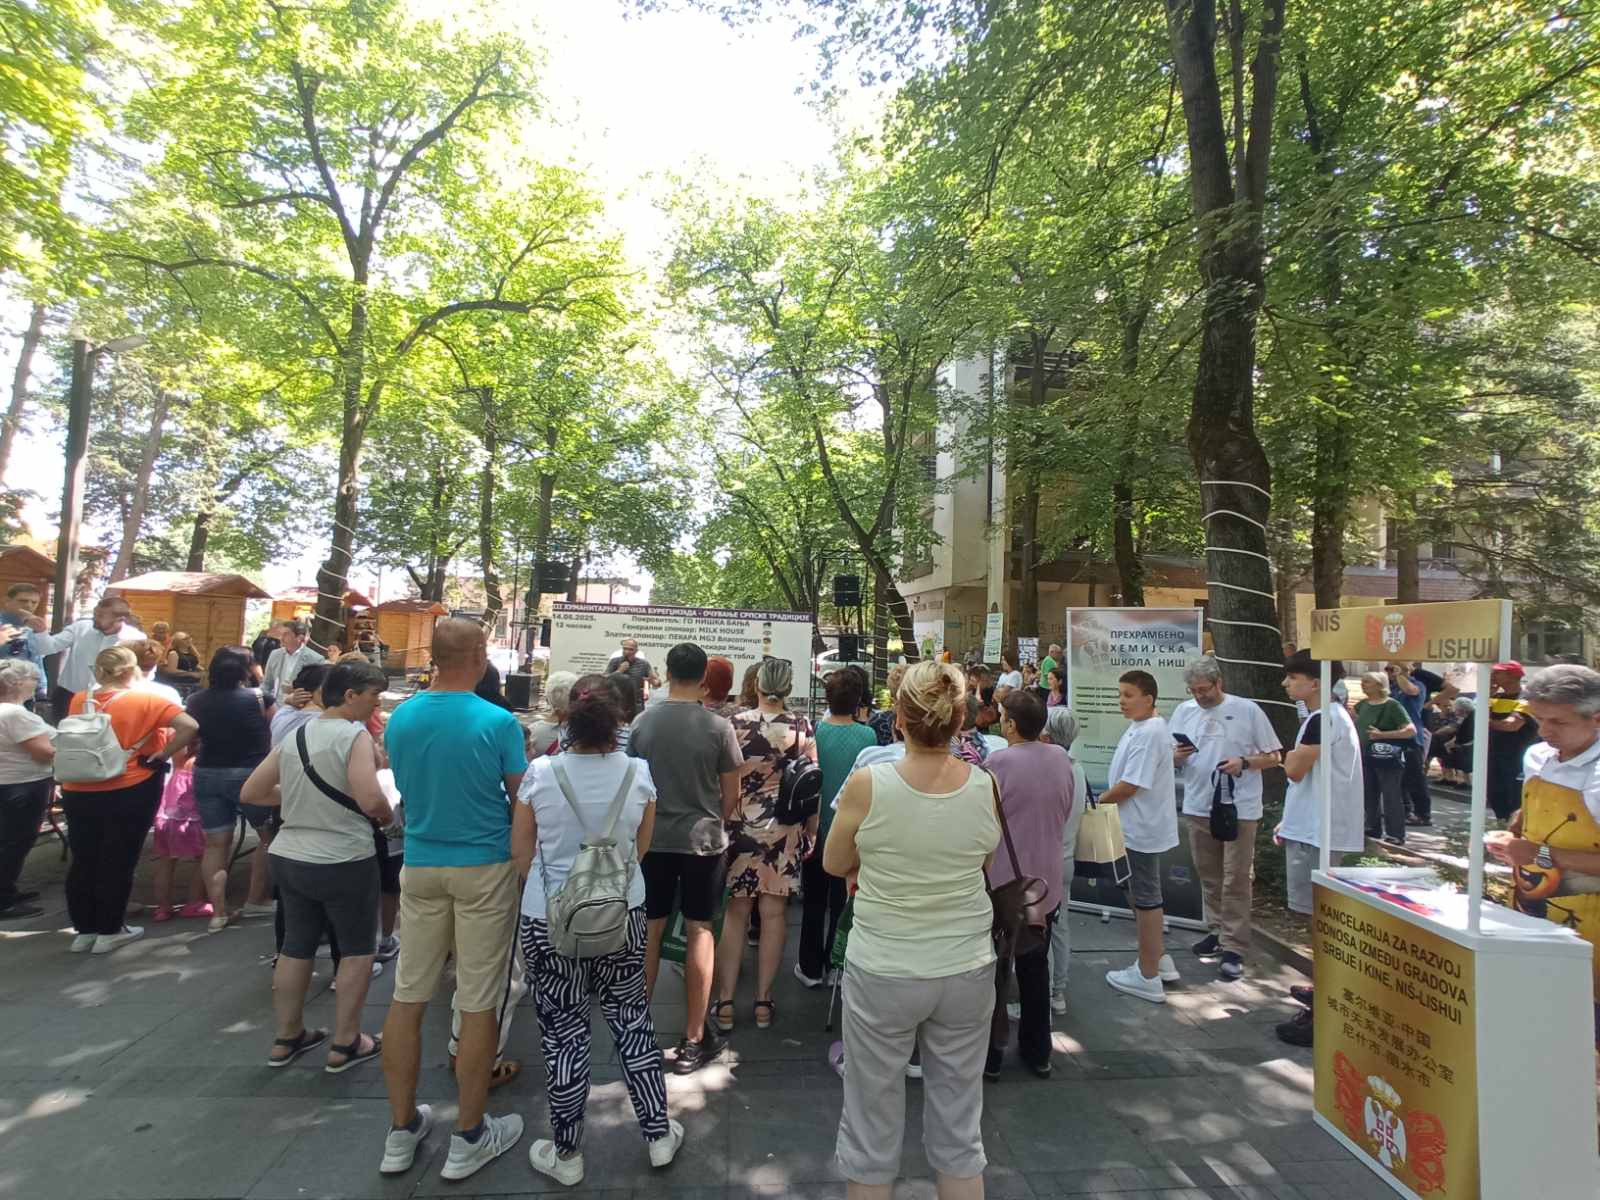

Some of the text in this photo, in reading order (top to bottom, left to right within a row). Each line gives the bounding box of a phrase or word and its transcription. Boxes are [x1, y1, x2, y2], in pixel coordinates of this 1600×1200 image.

[564, 604, 617, 612] ХУМАНИТАРНА
[618, 606, 646, 614] ДЕЧИЈА
[703, 610, 739, 618] ОЧУВАЊЕ
[769, 613, 810, 621] ТРАДИЦИЈЕ
[622, 623, 663, 631] Генерални
[695, 618, 725, 626] НИШКА
[1312, 610, 1341, 632] NIŠ
[668, 633, 698, 641] ПЕКАРА
[1110, 630, 1185, 640] ПРЕХРАМБЕНО
[1110, 644, 1186, 653] ХЕМИЈСКА
[1427, 638, 1493, 659] LISHUI
[1111, 658, 1185, 668] ШКОЛА НИШ
[1319, 903, 1462, 979] KANCELARIJA ZA RAZVOJ
[1316, 919, 1469, 1007] ODNOSA IZMEĐU GRADOVA
[1322, 940, 1358, 972] SRBIJE
[1395, 979, 1463, 1025] NIŠ-LISHUI
